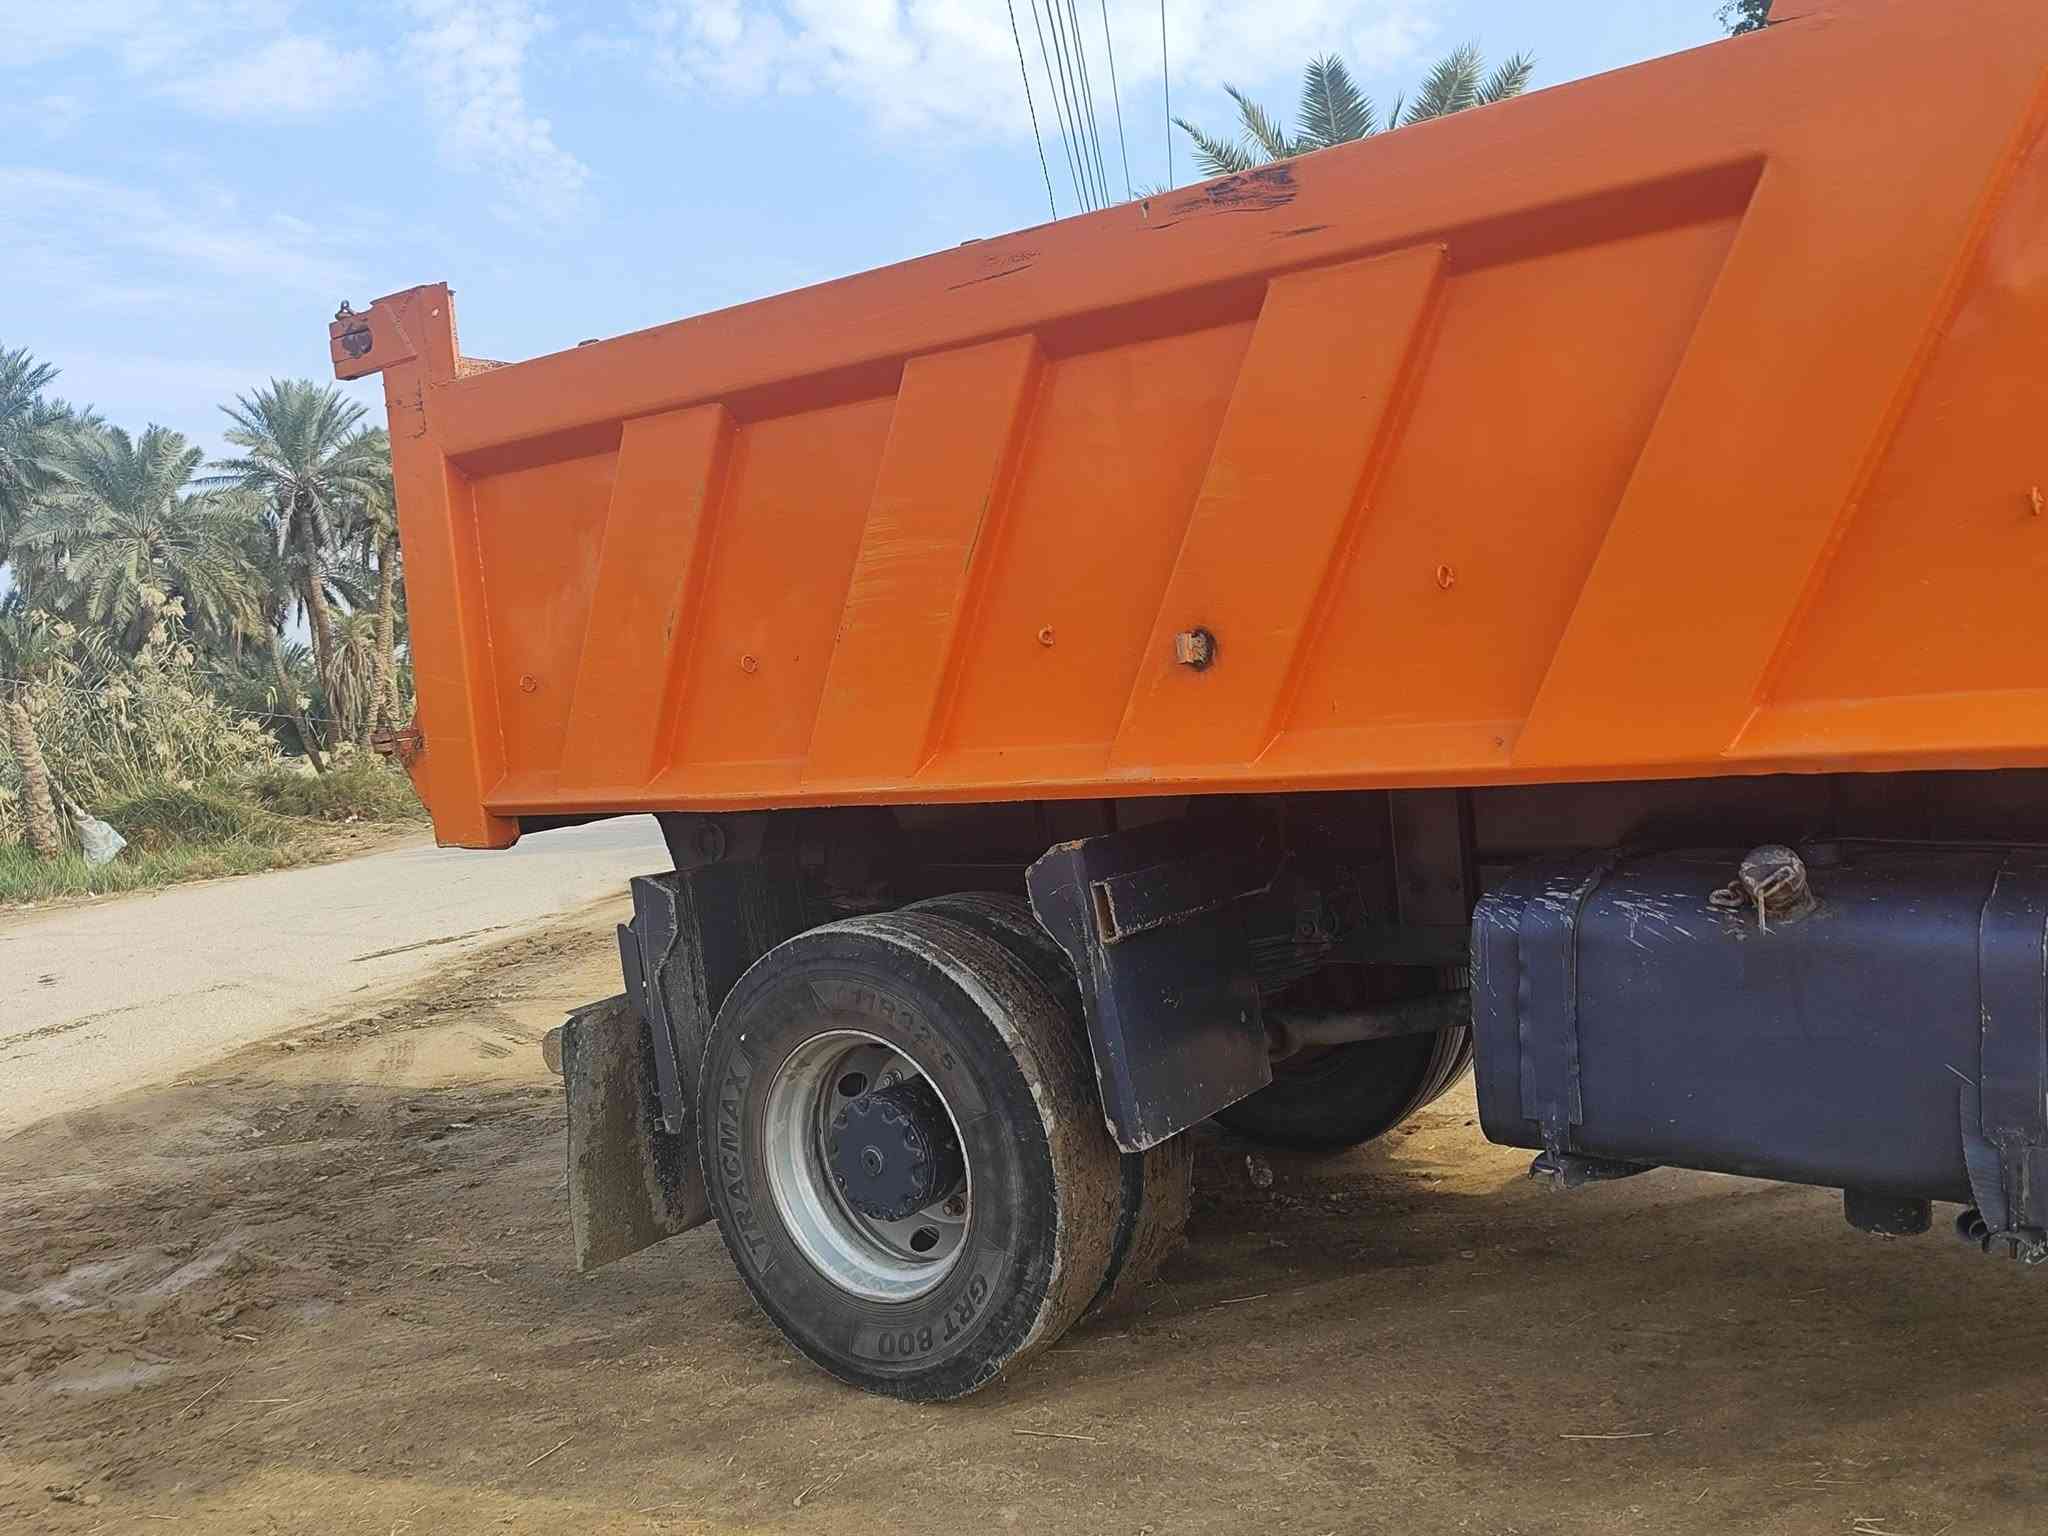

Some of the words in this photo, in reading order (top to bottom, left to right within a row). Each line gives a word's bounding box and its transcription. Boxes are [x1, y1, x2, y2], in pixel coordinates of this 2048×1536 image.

[719, 1065, 766, 1255] TRACMAX
[878, 1326, 934, 1355] 800
[943, 1273, 988, 1343] GRT
